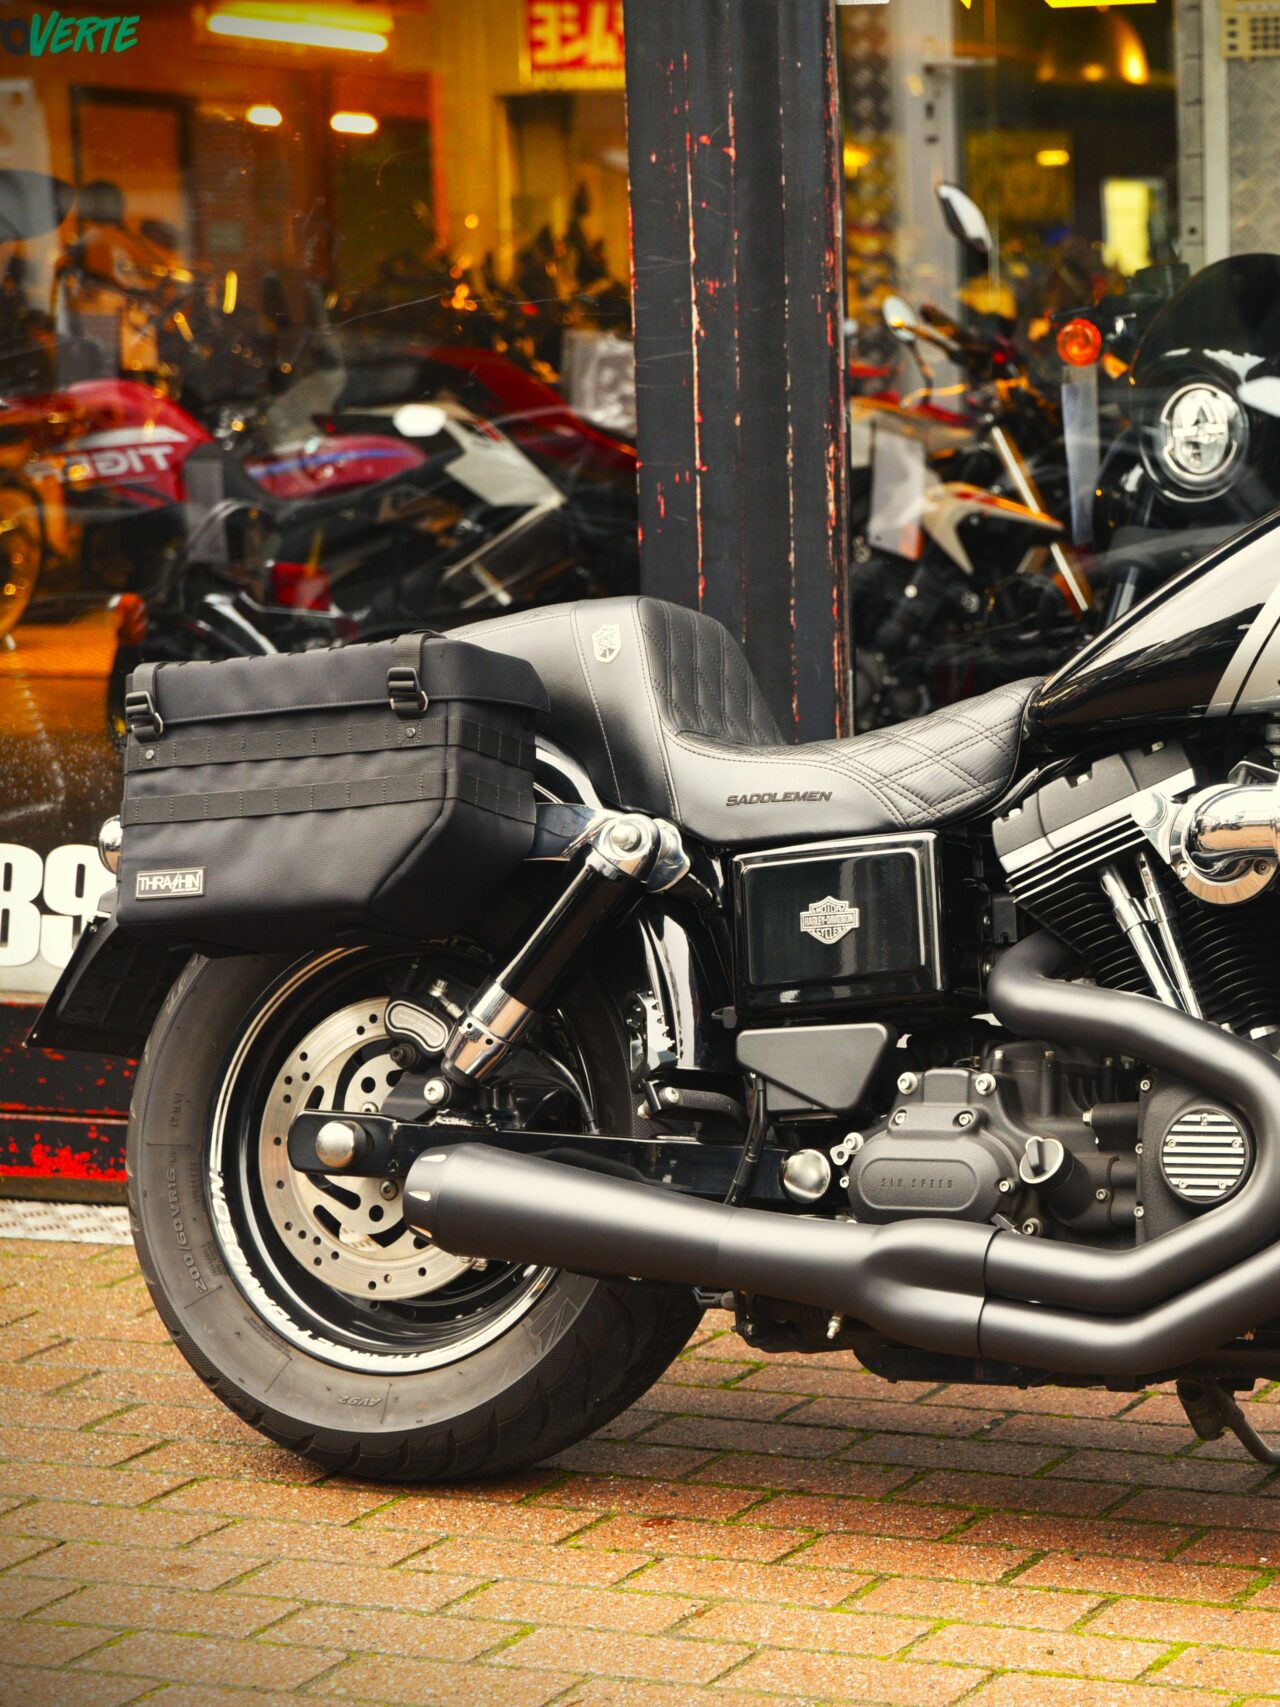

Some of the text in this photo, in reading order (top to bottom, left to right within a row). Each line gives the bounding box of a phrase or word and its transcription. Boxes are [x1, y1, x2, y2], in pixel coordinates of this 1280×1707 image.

[532, 3, 624, 64] ヨシム
[726, 791, 833, 806] SADDLEMEN
[881, 1178, 953, 1189] SIX SPEED
